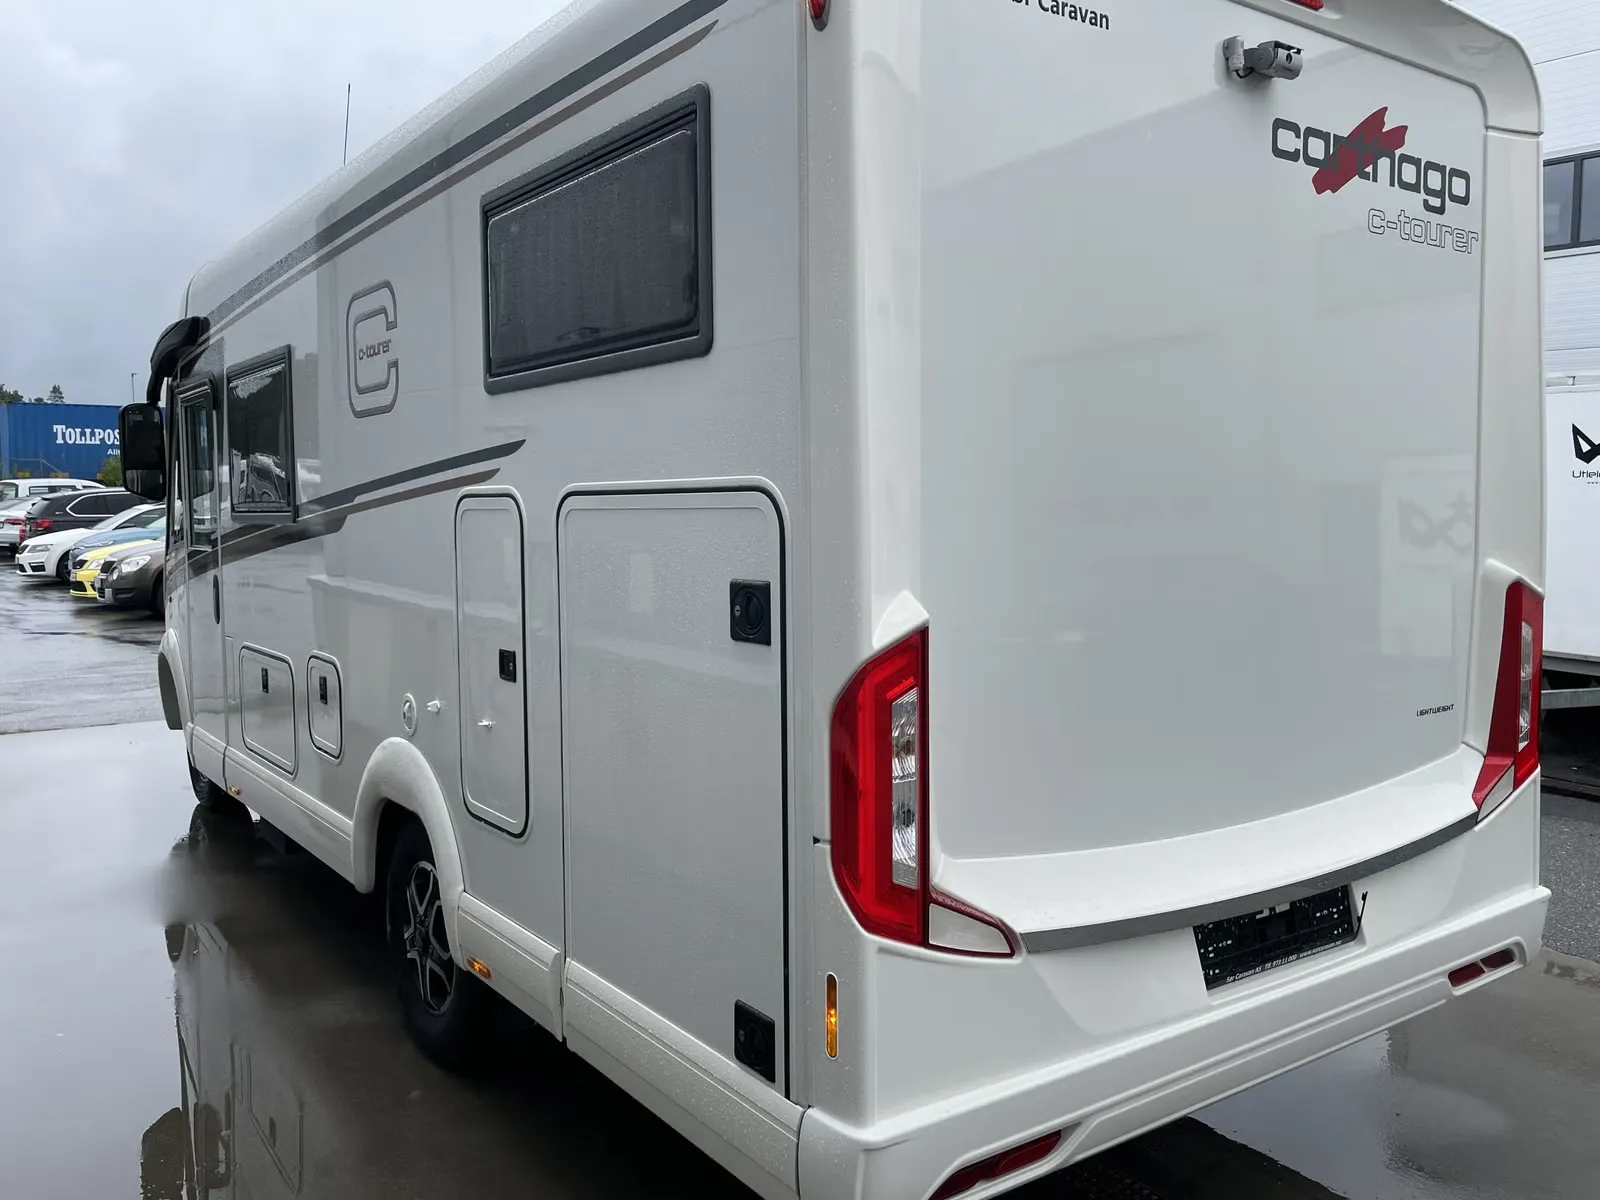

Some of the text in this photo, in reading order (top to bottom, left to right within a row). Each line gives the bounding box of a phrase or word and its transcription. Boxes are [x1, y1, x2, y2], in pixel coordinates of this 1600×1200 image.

[1038, 0, 1109, 30] Caravan
[1271, 117, 1471, 215] carthago
[1367, 208, 1479, 254] c-tourer
[358, 338, 392, 360] c-tourer
[1572, 470, 1600, 479] Utlei
[1416, 703, 1455, 717] LIGHTWEIGHT
